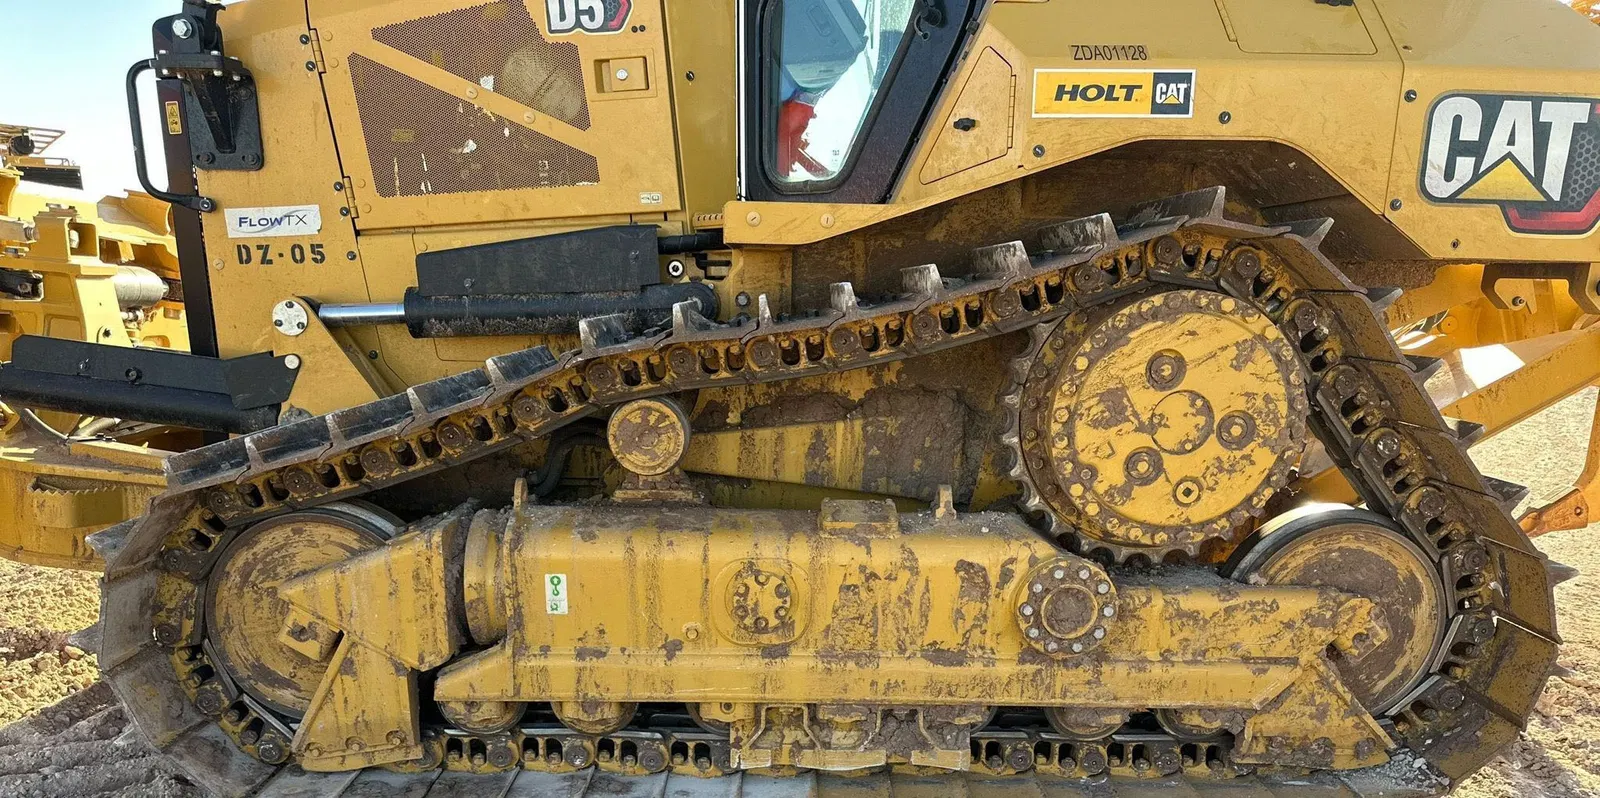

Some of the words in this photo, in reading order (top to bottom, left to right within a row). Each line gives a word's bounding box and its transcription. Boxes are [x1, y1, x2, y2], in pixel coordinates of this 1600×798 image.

[1071, 44, 1148, 61] ZDA01128
[1155, 82, 1188, 105] CAT
[1424, 96, 1592, 202] CAT
